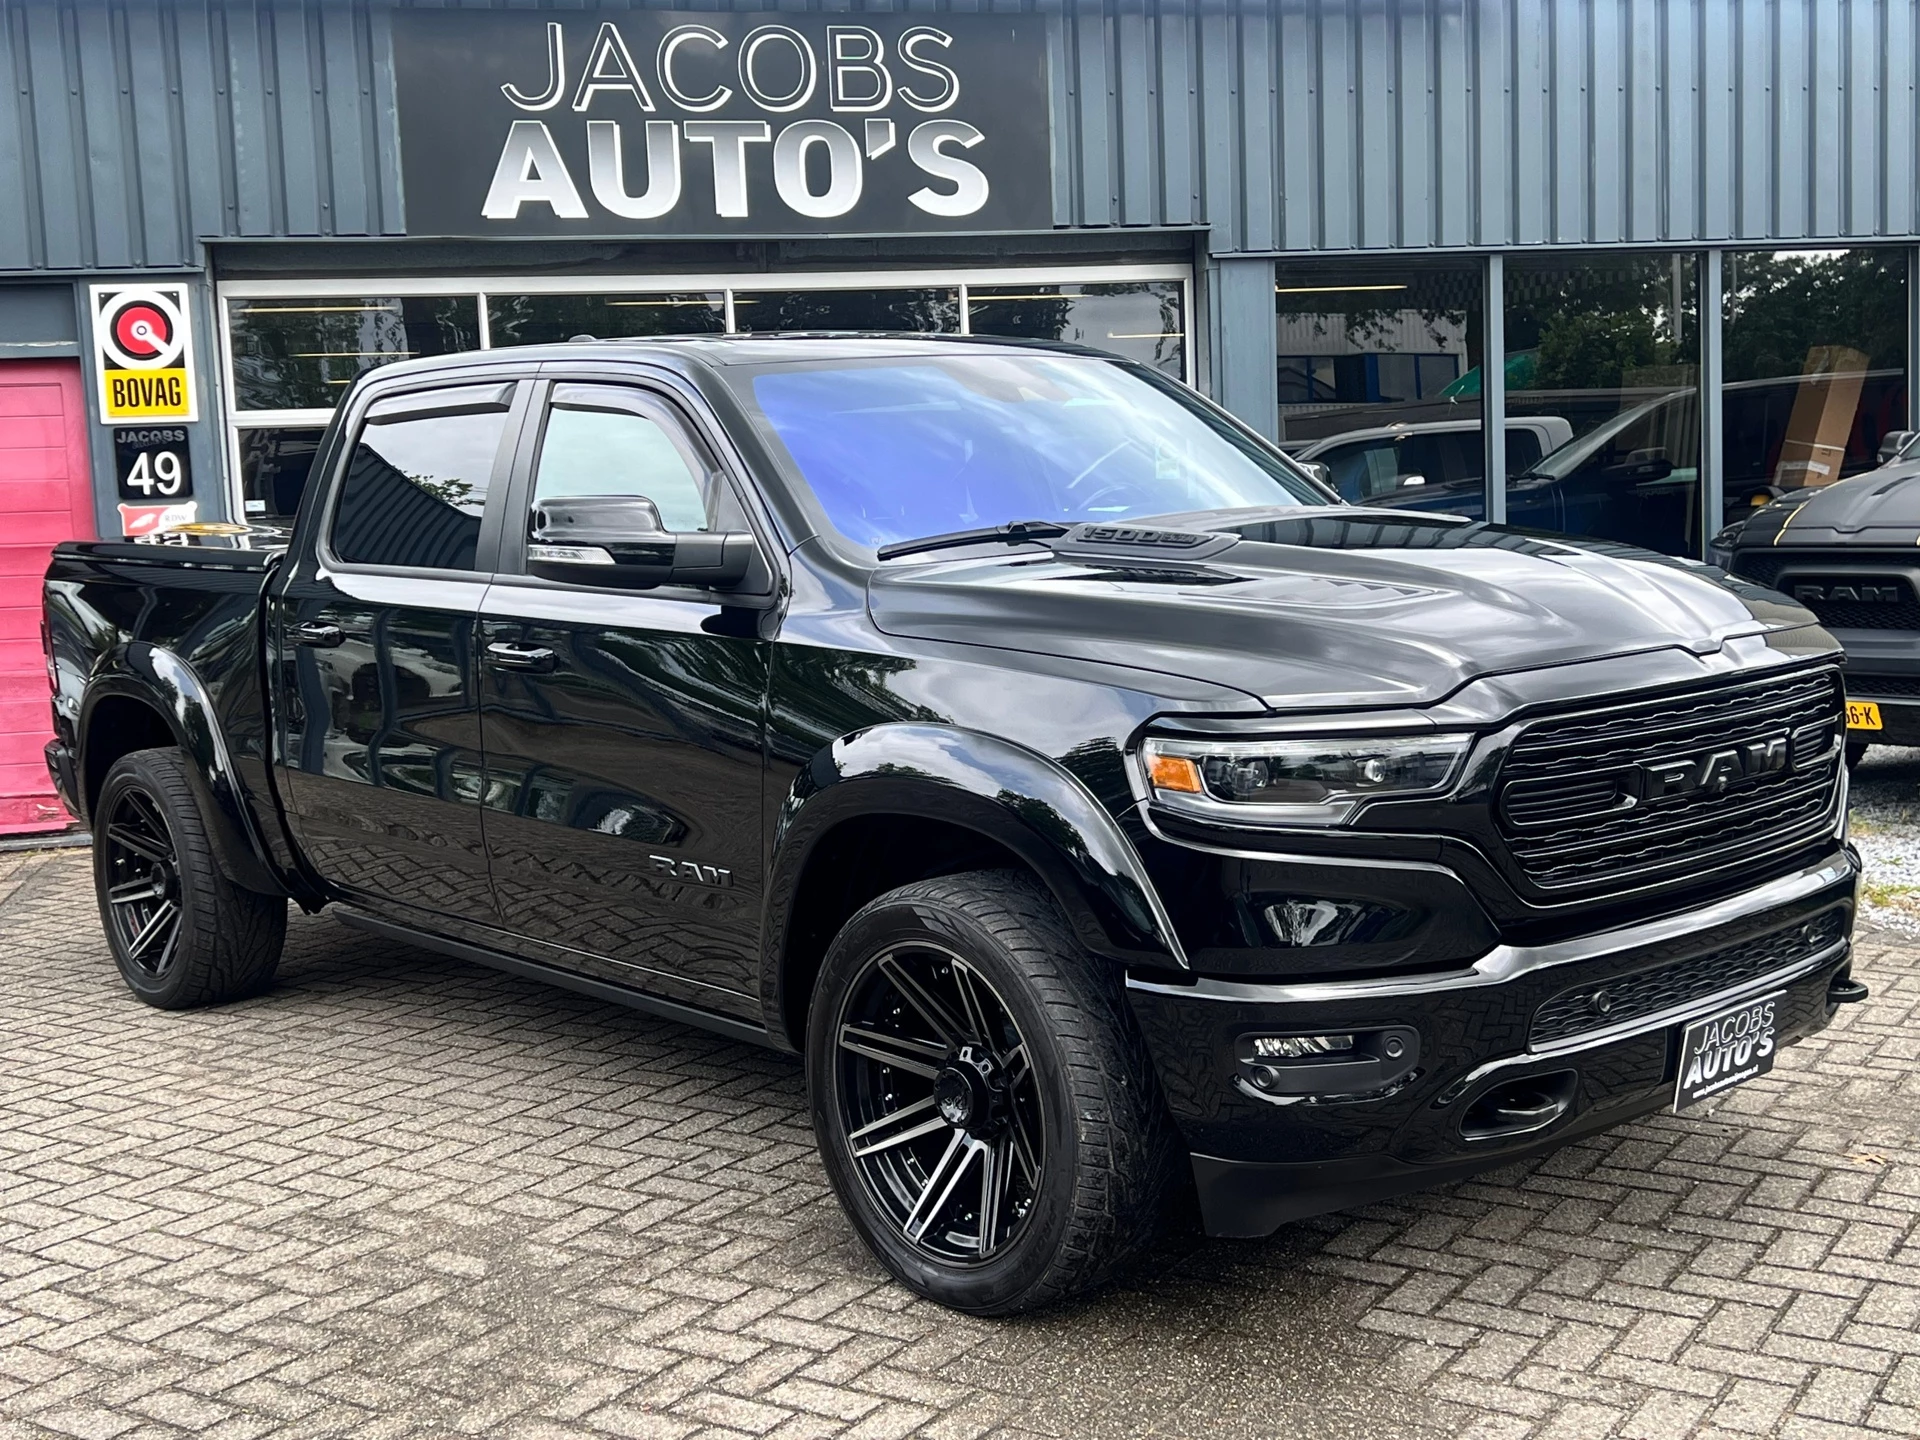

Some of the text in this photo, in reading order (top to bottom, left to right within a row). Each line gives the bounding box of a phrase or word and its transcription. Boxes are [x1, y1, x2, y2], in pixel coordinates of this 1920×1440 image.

[500, 22, 960, 112] JACOBS
[481, 118, 989, 219] AUTO'S
[112, 377, 182, 407] BOVAG
[116, 430, 185, 443] JACOBS
[127, 451, 181, 495] 49
[1083, 525, 1161, 543] 1500
[1794, 584, 1899, 602] RAM
[1646, 737, 1788, 797] RAM
[648, 854, 734, 887] RAM
[1694, 1001, 1775, 1054] JACOBS
[1683, 1026, 1775, 1089] AUTO'S
